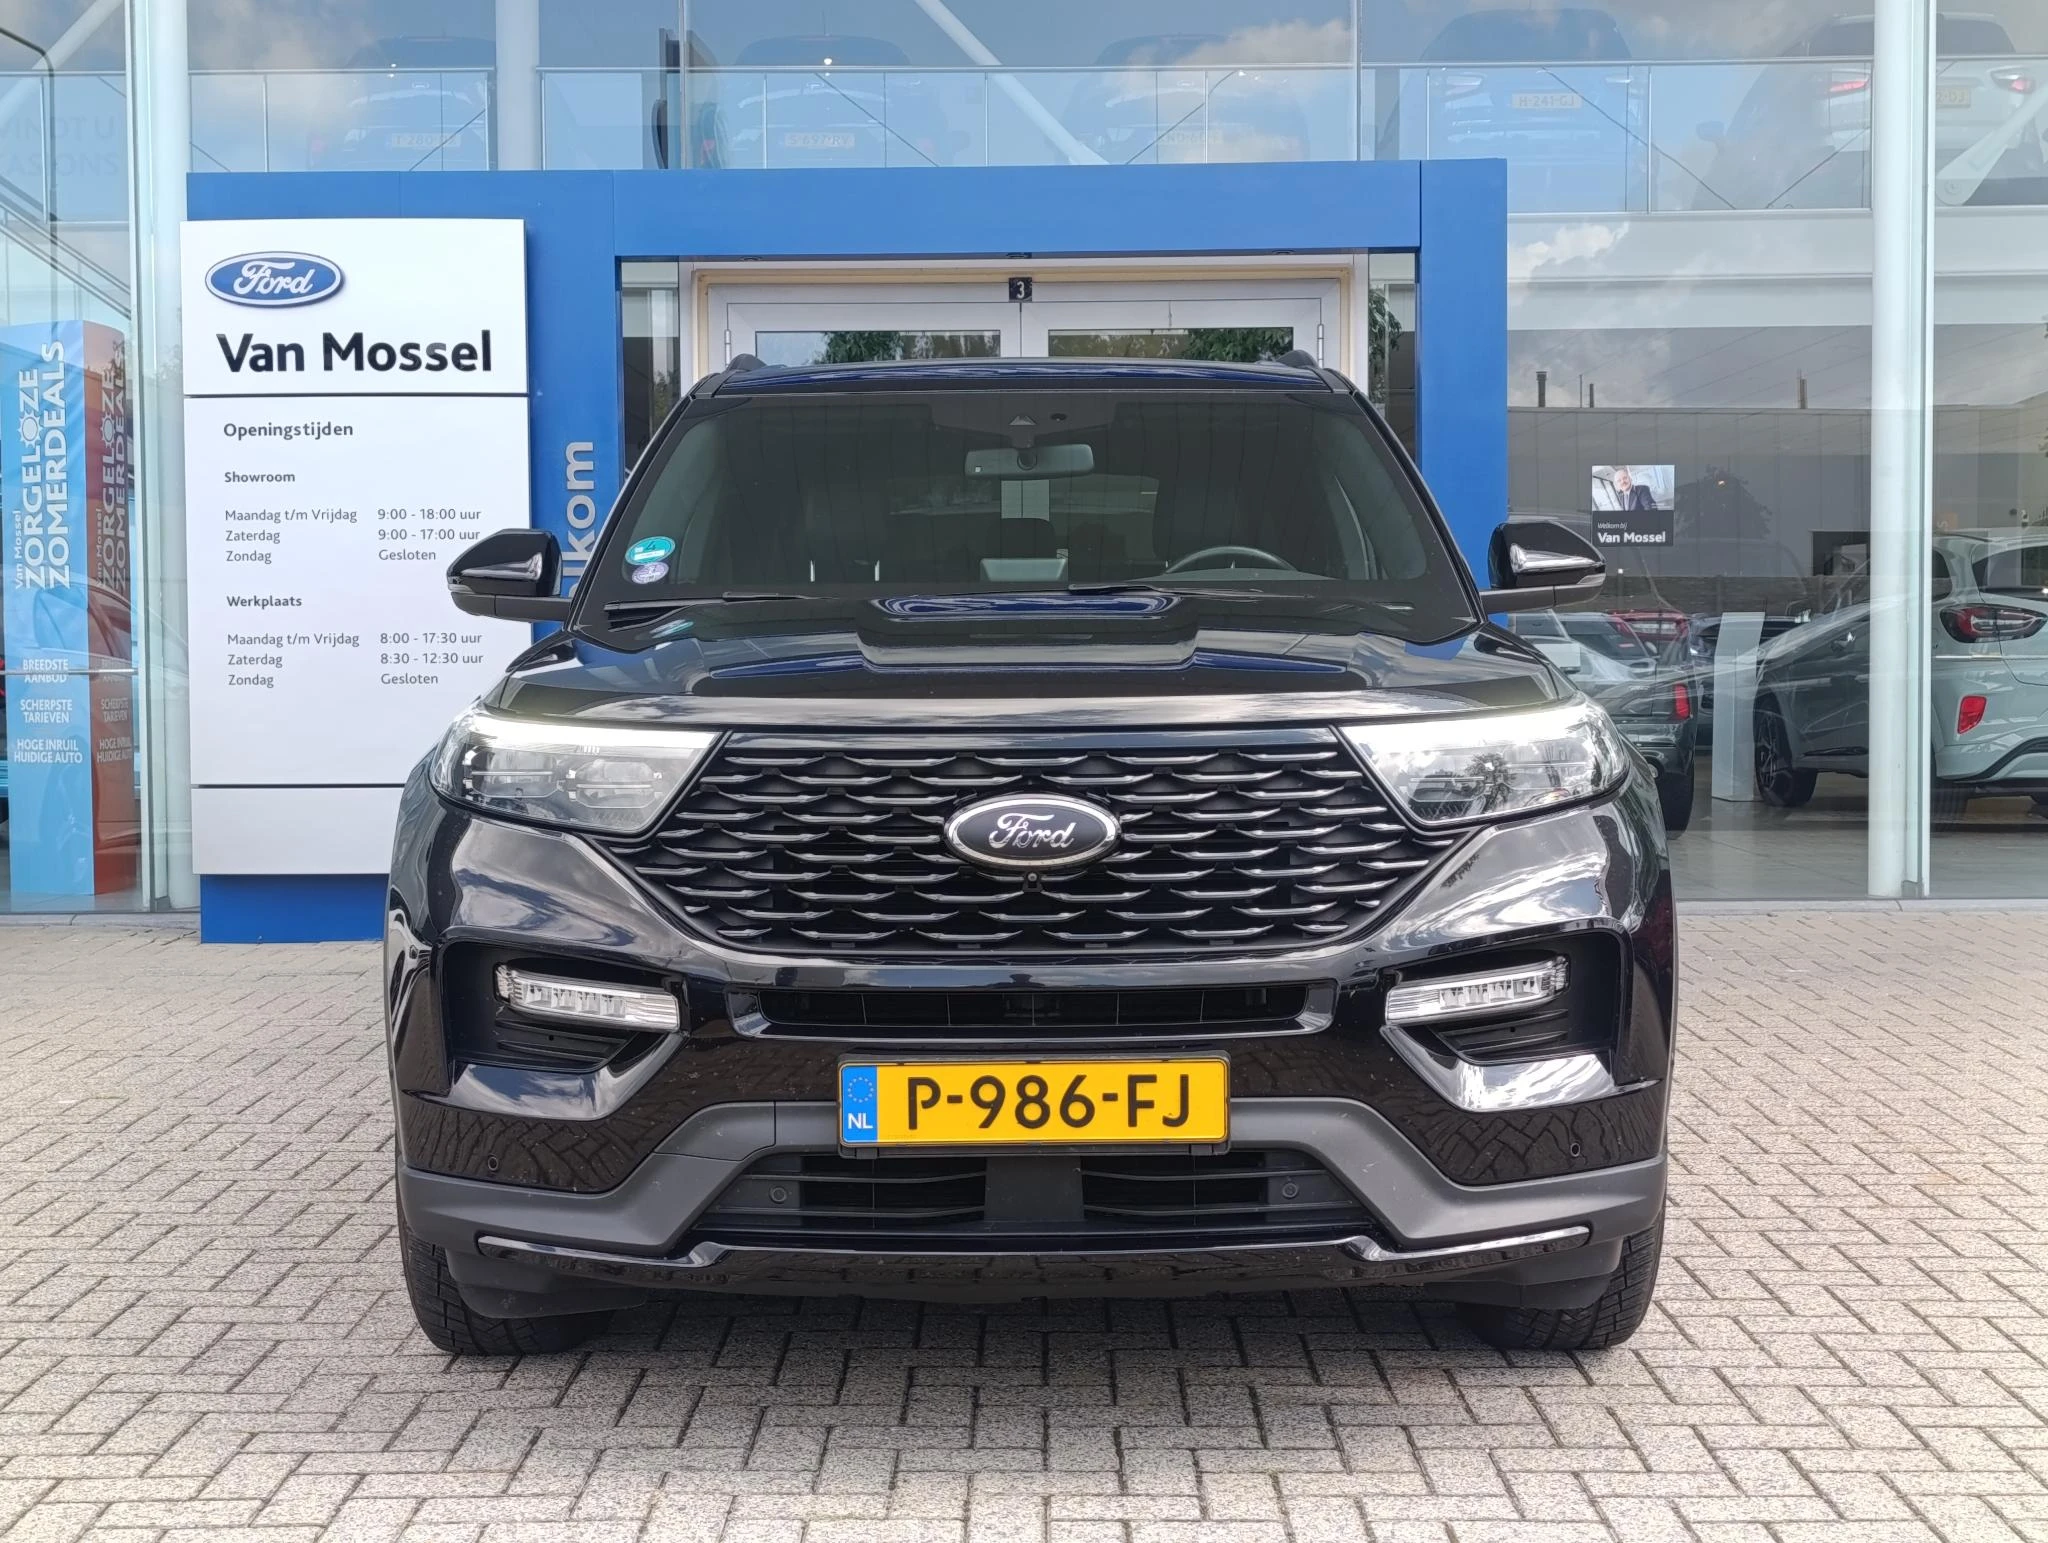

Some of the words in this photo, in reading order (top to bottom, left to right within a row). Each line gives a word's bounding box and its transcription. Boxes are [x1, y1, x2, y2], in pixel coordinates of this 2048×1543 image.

[1519, 95, 1574, 107] H-241-GJ
[233, 259, 316, 295] Ford
[1016, 280, 1025, 299] 3
[216, 332, 306, 373] Van
[322, 329, 492, 373] Mossel
[223, 421, 354, 441] Openingstijden
[41, 340, 71, 590] ZOMERDEALS
[224, 471, 296, 483] Showroom
[225, 509, 282, 524] Maandag
[284, 508, 308, 521] t/m
[311, 508, 358, 524] Vrijdag
[377, 508, 408, 520] 9:00
[419, 508, 456, 520] 18:00
[459, 511, 482, 520] uur
[13, 510, 22, 555] Mossel
[225, 529, 281, 545] Zaterdag
[377, 528, 408, 541] 9:00
[420, 528, 456, 541] 17:00
[459, 531, 480, 541] uur
[1597, 531, 1621, 543] Van
[1623, 531, 1667, 543] Mossel
[225, 549, 273, 565] Zondag
[378, 548, 437, 561] Gesloten
[15, 557, 23, 590] Van
[227, 595, 303, 610] Werkplaats
[227, 632, 284, 648] Maandag
[286, 632, 310, 645] t/m
[313, 632, 360, 648] Vrijdag
[379, 632, 410, 644] 8:00
[422, 632, 457, 644] 17:30
[460, 634, 483, 644] uur
[23, 659, 69, 672] BREEDSTE
[227, 652, 283, 669] Zaterdag
[380, 652, 410, 664] 8:30
[422, 652, 459, 664] 12:30
[462, 655, 484, 664] uur
[227, 673, 275, 689] Zondag
[380, 672, 439, 685] Gesloten
[20, 699, 73, 712] SCHERPSTE
[24, 711, 70, 724] TARIEVEN
[17, 739, 44, 752] HOGE
[45, 738, 79, 751] INRUIL
[14, 751, 54, 764] HUIDIGE
[55, 751, 83, 764] AUTO
[988, 812, 1077, 849] Ford
[906, 1073, 1190, 1131] P-986-FJ
[847, 1112, 874, 1130] NL
